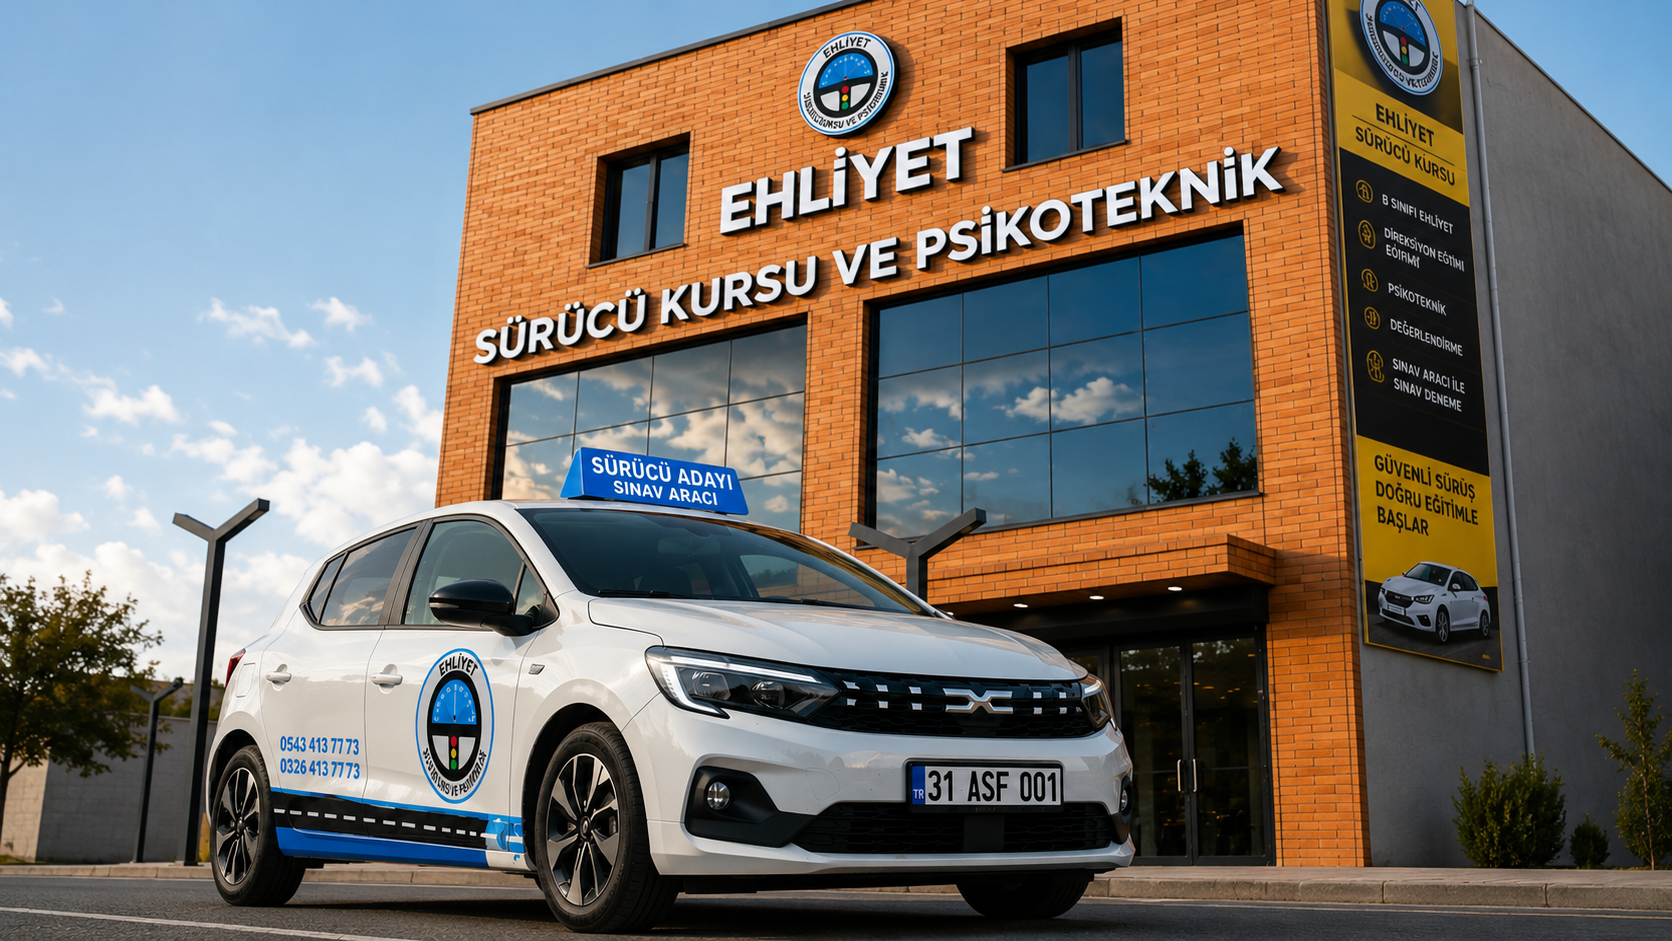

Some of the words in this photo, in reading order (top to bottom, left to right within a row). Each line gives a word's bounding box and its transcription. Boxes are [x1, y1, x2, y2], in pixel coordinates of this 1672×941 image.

[823, 36, 871, 59] EHLİYET
[1376, 103, 1434, 147] EHLİYET
[719, 126, 975, 235] EHLİYET
[1414, 153, 1455, 186] KURSU
[1382, 194, 1389, 206] B
[1391, 198, 1417, 218] SINIFI
[1419, 210, 1454, 235] EHLİYET
[473, 288, 647, 366] SÜRÜCÜ
[660, 255, 817, 326] KURSU
[833, 236, 899, 286] VE
[916, 146, 1284, 271] PSİKOTEKNİK
[1384, 227, 1436, 259] DİREKSİYON
[1388, 282, 1447, 316] PSİKOTEKNİK
[1390, 318, 1463, 356] DEĞERLENDİRME
[1392, 358, 1420, 377] SINAV
[1423, 369, 1450, 389] ARACI
[1451, 376, 1465, 394] İLE
[1394, 378, 1422, 397] SINAV
[1424, 388, 1462, 412] DENEME
[592, 454, 671, 482] SÜRÜCÜ
[678, 468, 733, 490] ADAYI
[1374, 453, 1431, 486] GÜVENLİ
[1435, 472, 1476, 503] SÜRÜŞ
[613, 480, 664, 499] SINAV
[669, 487, 718, 506] ARACI
[1376, 480, 1421, 508] DOĞRU
[1425, 494, 1478, 525] EĞİTİMLE
[1377, 506, 1429, 536] BAŞLAR
[438, 653, 478, 676] EHLİYET
[280, 735, 306, 753] 0543
[308, 737, 328, 754] 413
[280, 757, 307, 775] 0326
[309, 760, 329, 777] 413
[913, 788, 925, 800] TR
[927, 770, 953, 802] 31
[967, 771, 1010, 802] ASF
[1020, 771, 1057, 802] 001
